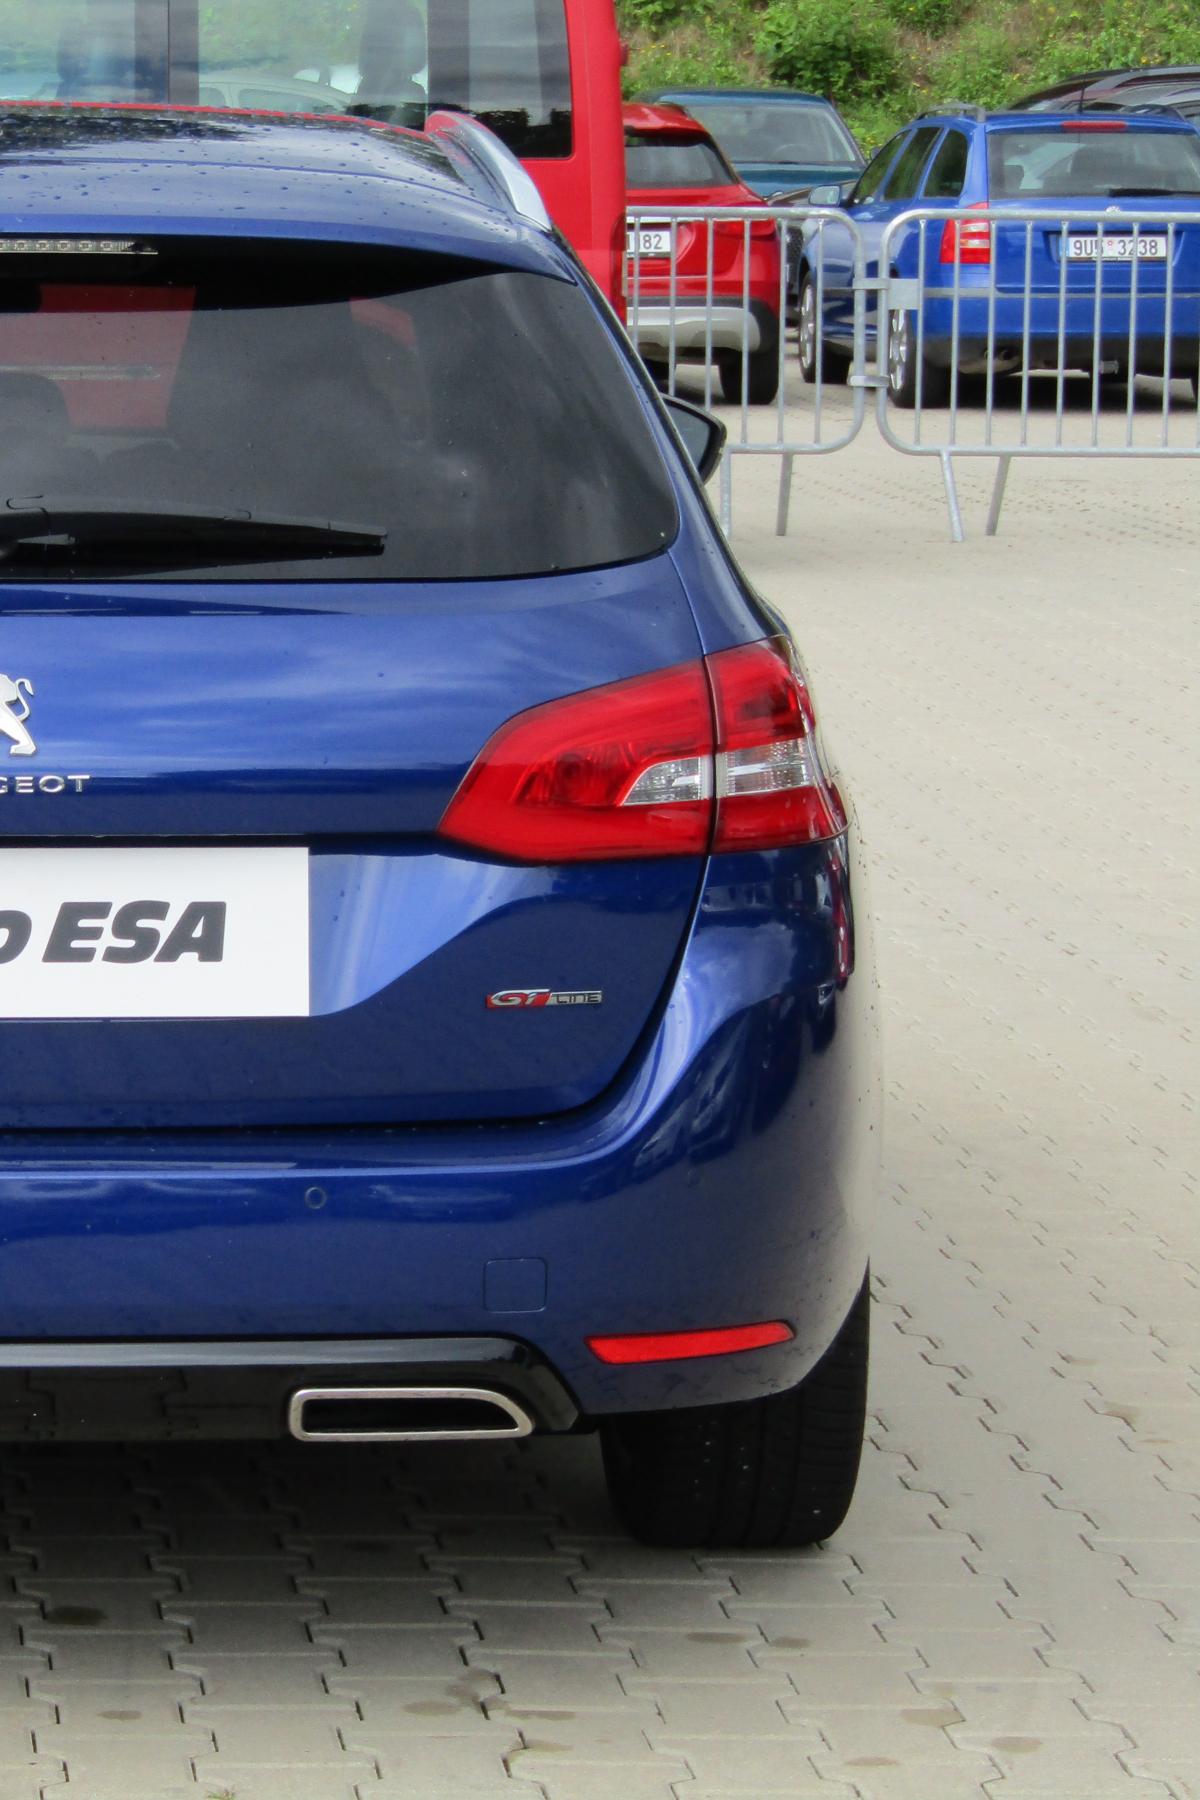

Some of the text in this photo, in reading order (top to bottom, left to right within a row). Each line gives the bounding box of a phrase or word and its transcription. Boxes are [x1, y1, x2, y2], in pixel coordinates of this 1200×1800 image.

[1118, 239, 1158, 256] 3238
[41, 899, 228, 965] ESA
[488, 988, 551, 1007] GT
